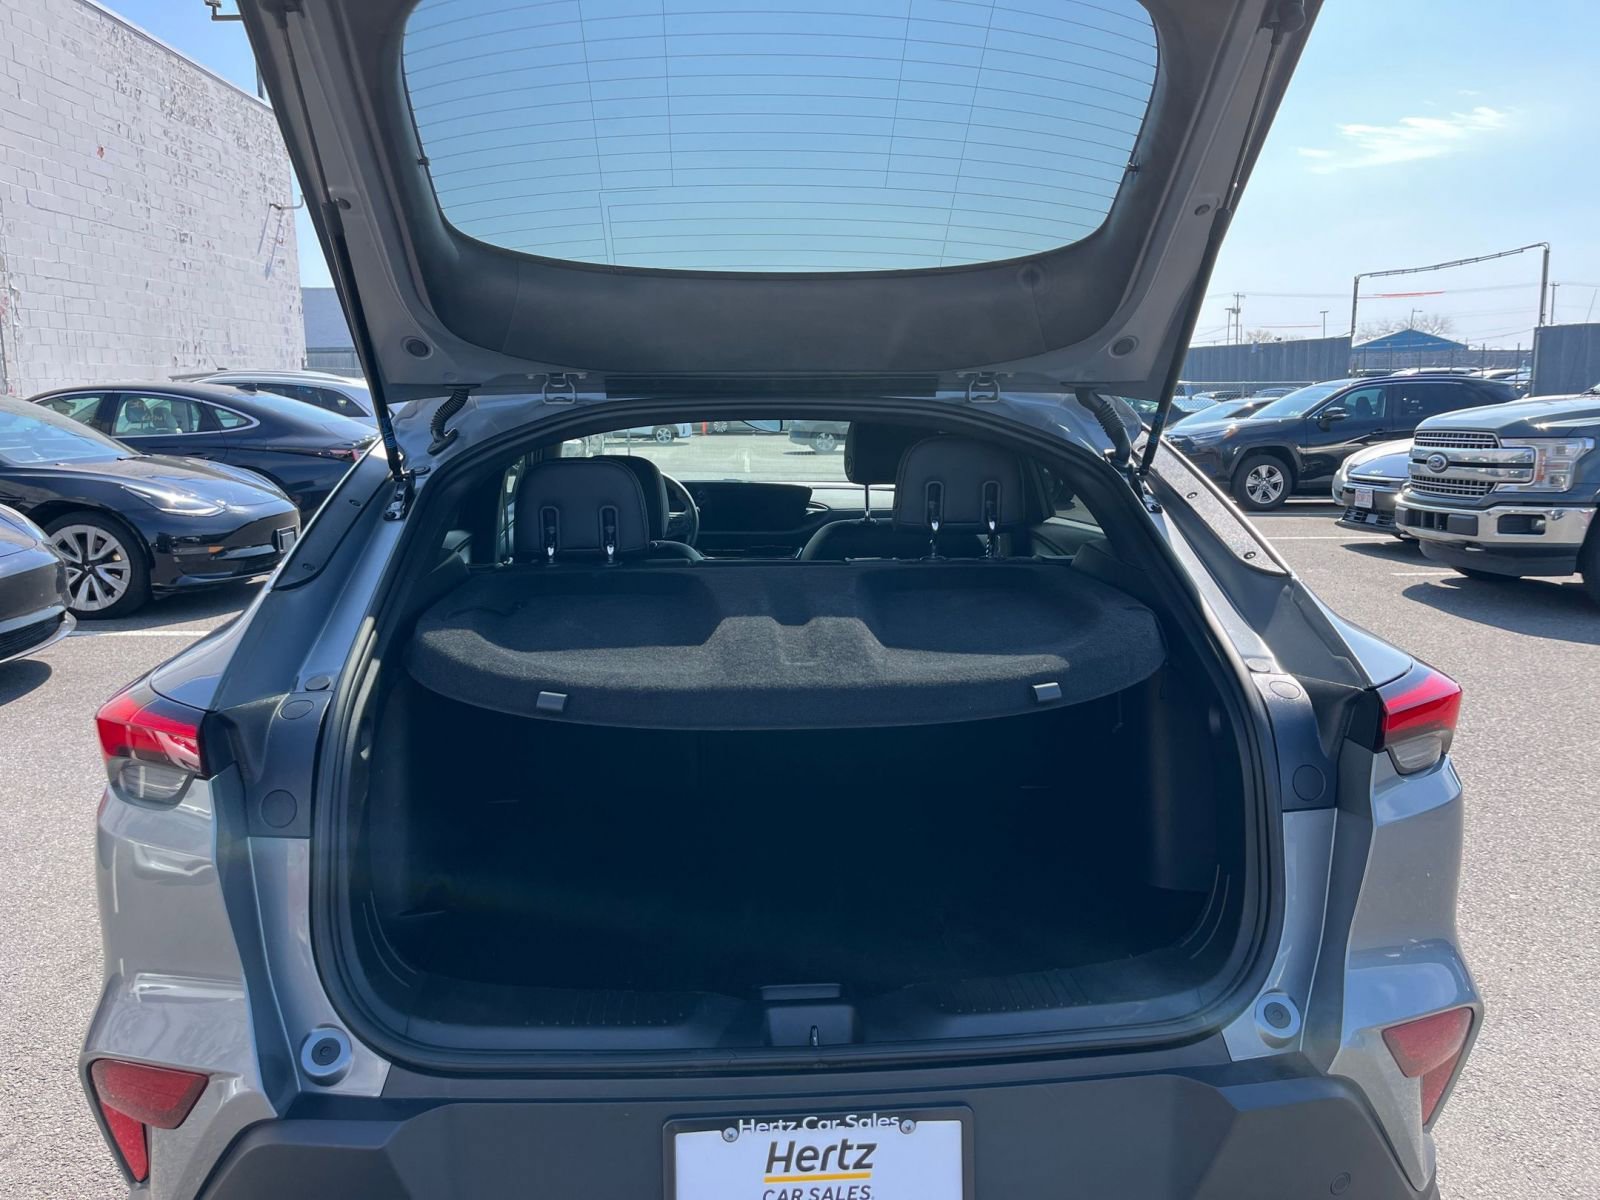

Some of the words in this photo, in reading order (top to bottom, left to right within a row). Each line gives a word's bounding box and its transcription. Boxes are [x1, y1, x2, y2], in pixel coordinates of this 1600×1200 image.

[738, 1119, 797, 1133] Hertz
[802, 1116, 841, 1130] Car
[845, 1113, 900, 1129] Sales
[765, 1138, 877, 1173] Hertz
[762, 1188, 803, 1200] CAR
